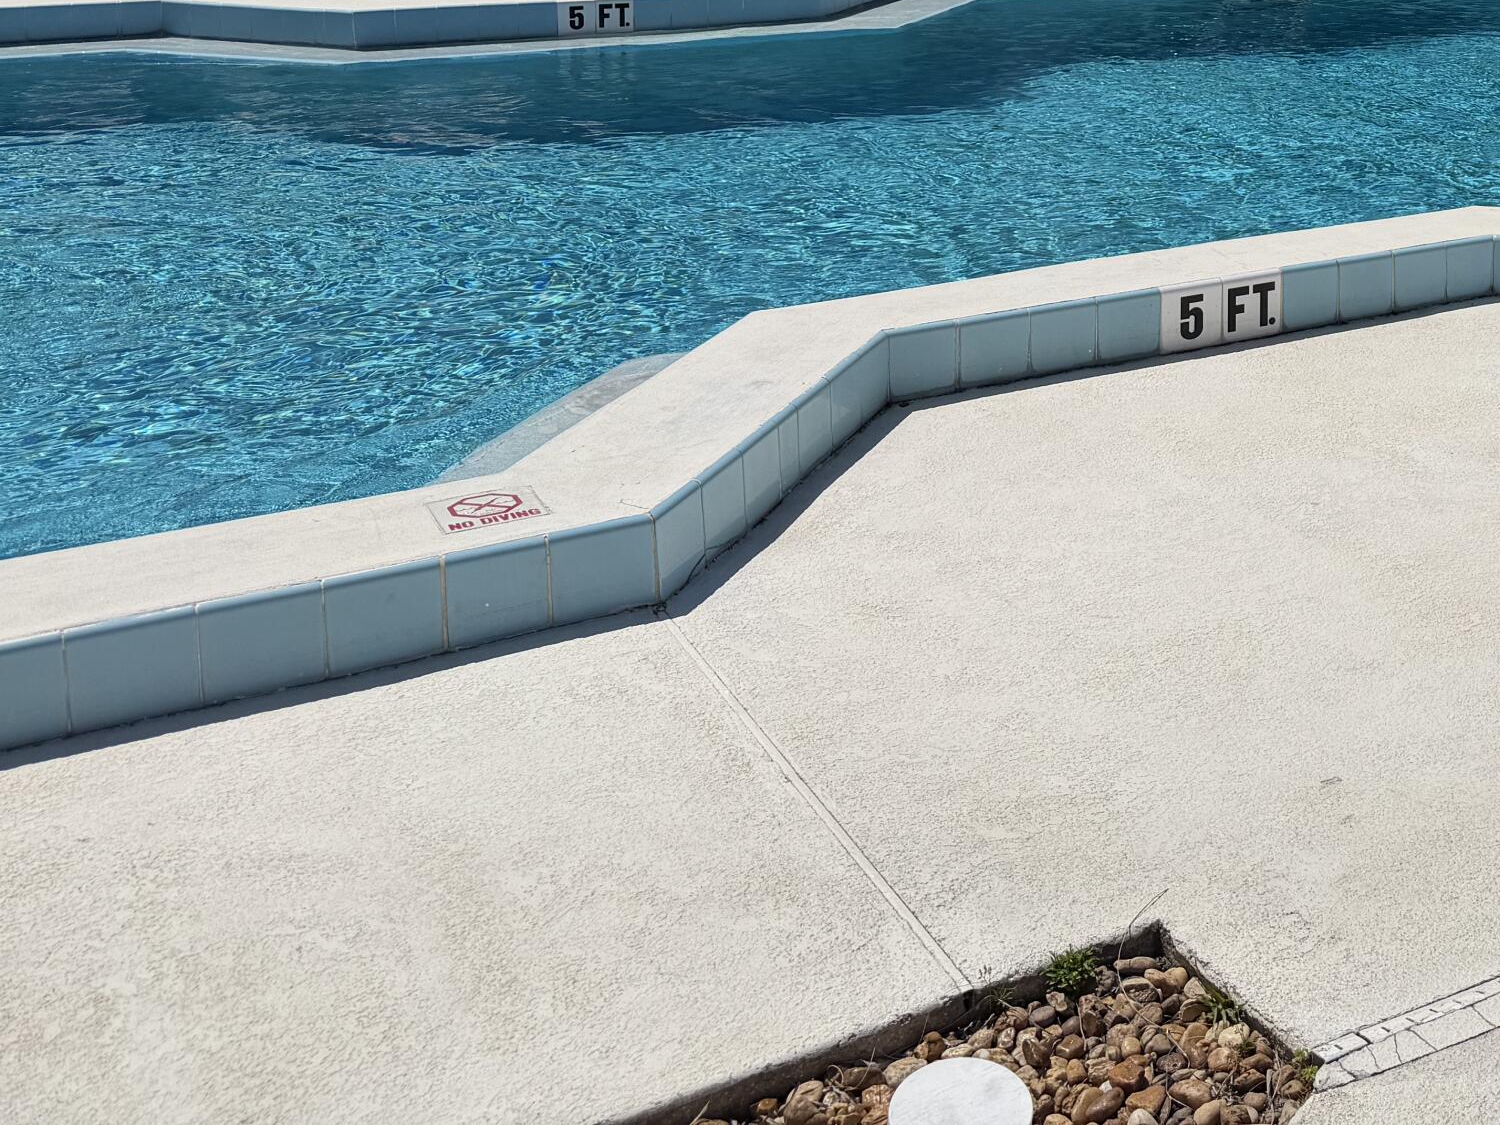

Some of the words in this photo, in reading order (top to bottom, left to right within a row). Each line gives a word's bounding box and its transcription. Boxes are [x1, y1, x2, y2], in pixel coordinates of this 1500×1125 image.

[569, 5, 584, 30] 5
[599, 3, 630, 28] FT.
[1180, 293, 1204, 340] 5
[1227, 281, 1276, 333] FT.
[448, 520, 475, 531] NO
[480, 508, 542, 525] DIVING
